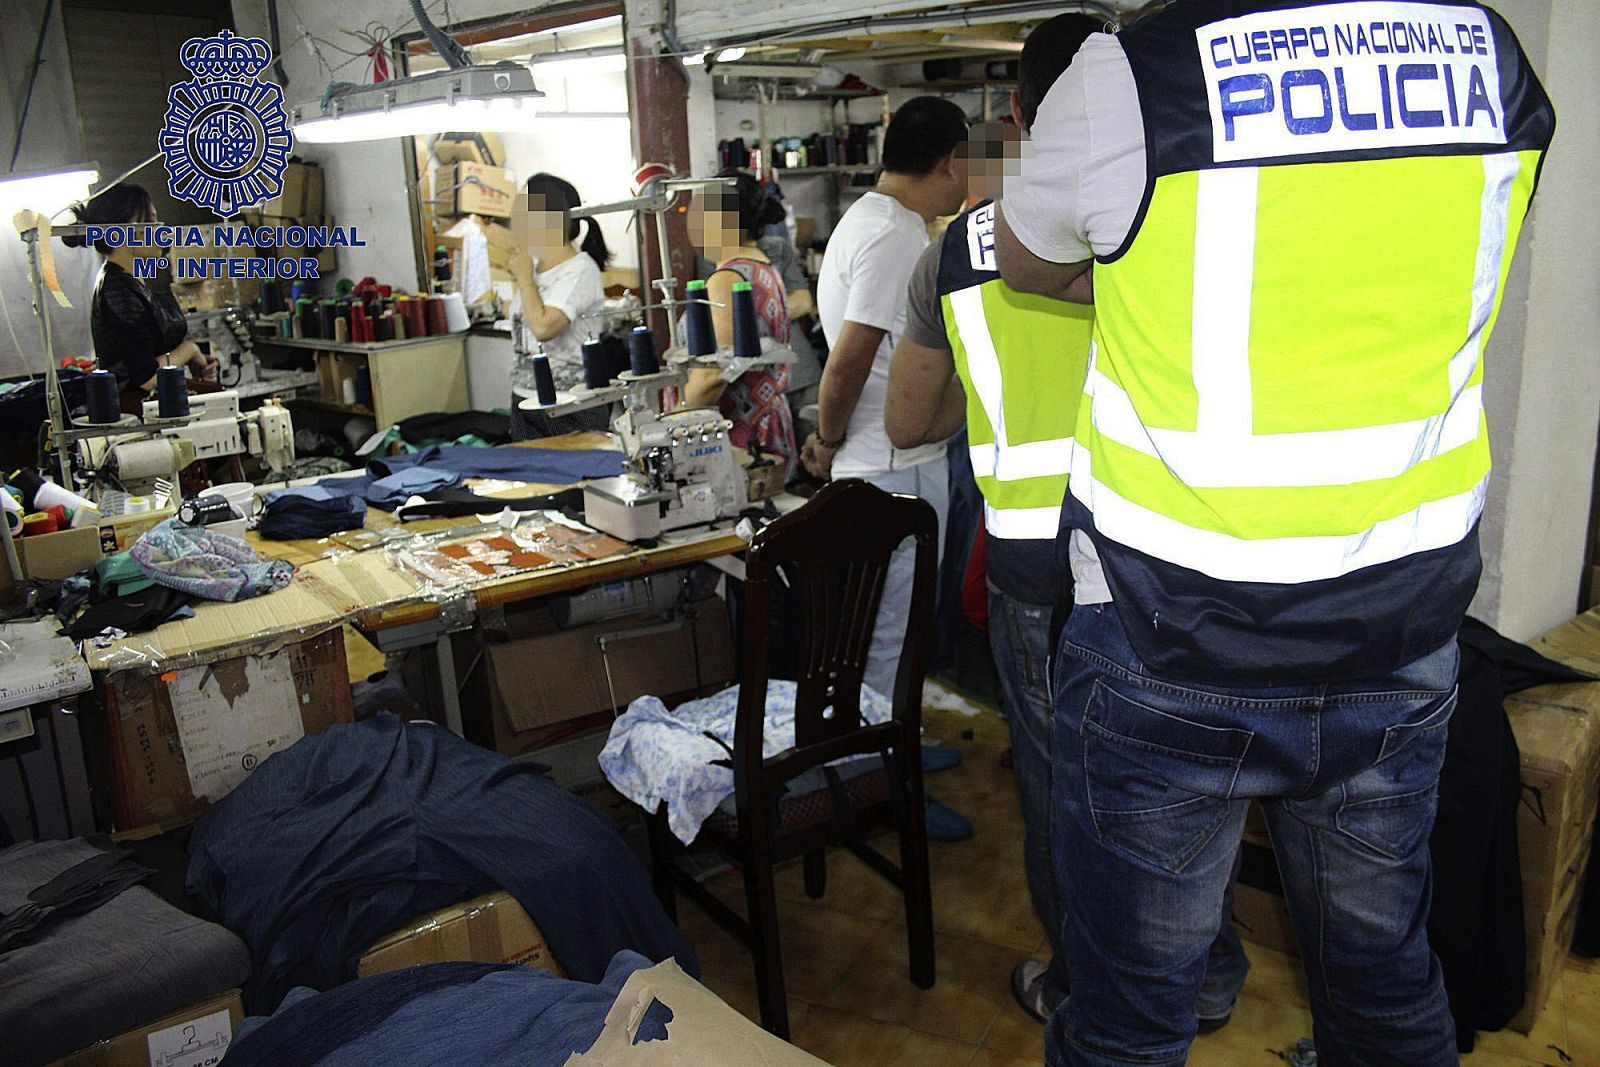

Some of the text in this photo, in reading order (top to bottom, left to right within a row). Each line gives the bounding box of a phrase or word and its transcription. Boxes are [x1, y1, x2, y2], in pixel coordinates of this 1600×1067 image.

[1210, 22, 1487, 68] CUERPO NACIONAL DE
[1218, 64, 1498, 141] POLICIA
